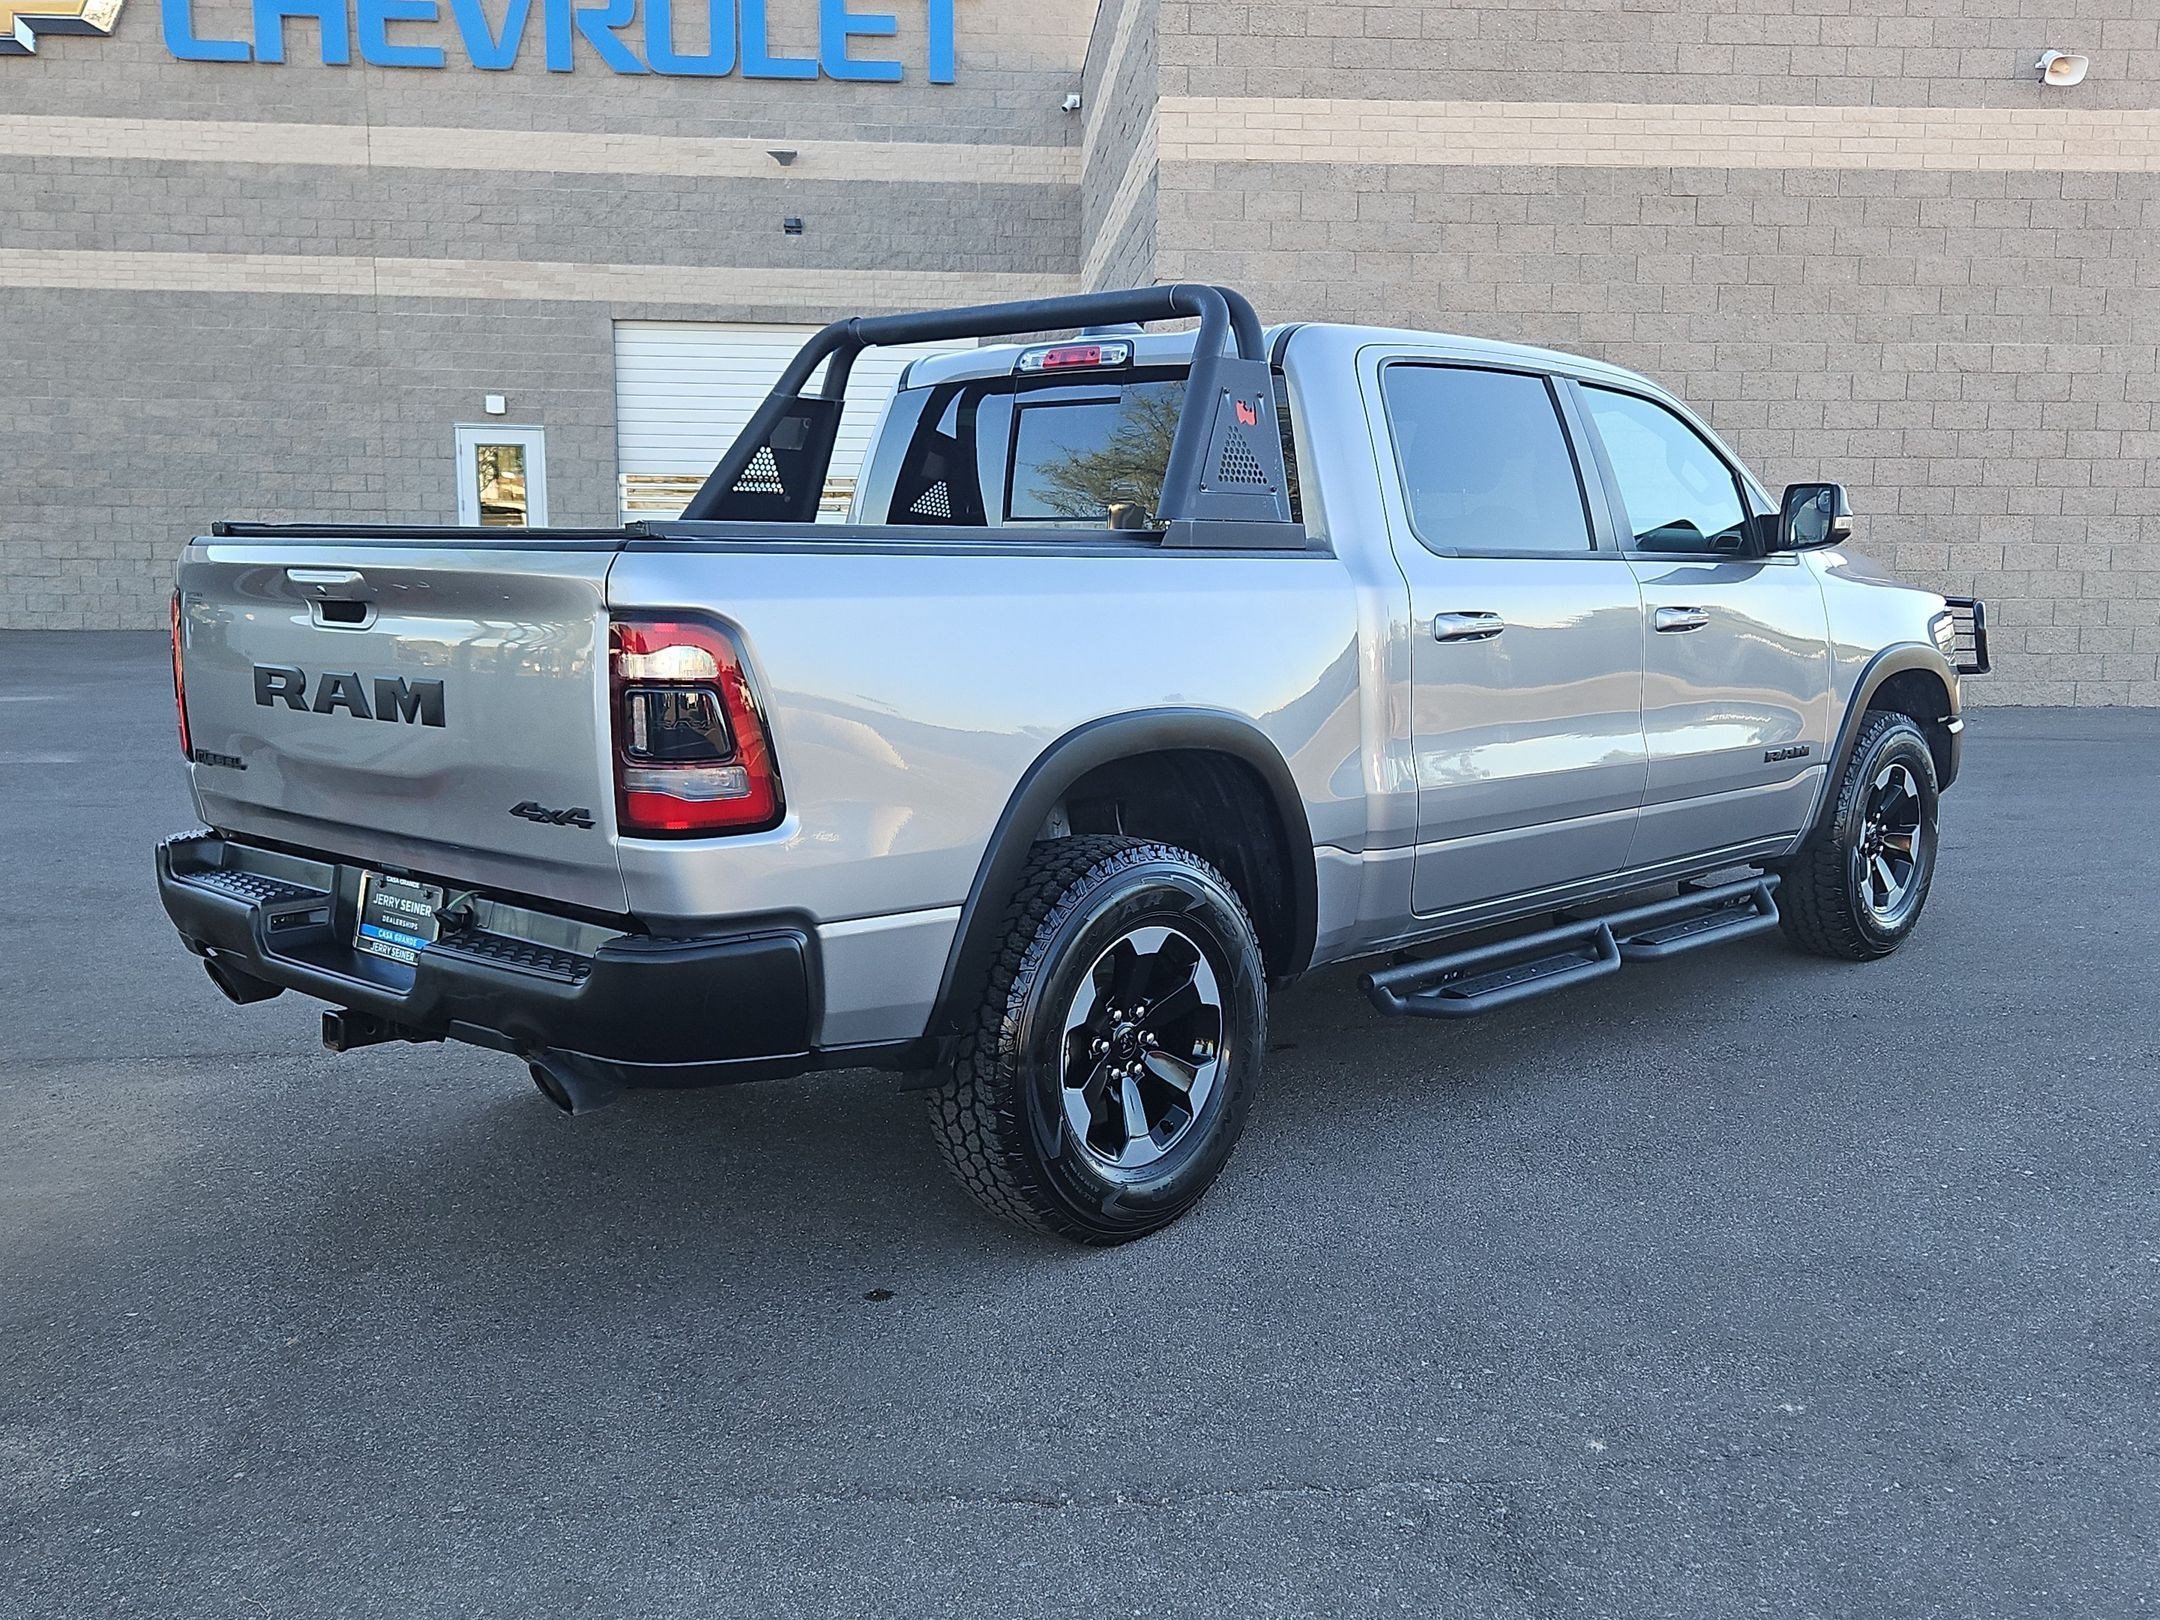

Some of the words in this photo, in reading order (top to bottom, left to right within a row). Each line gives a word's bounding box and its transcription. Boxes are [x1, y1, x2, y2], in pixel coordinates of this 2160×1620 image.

[252, 662, 447, 728] RAM
[373, 892, 400, 909] JERRY
[400, 899, 432, 917] SEINER
[382, 915, 418, 931] DEALERSHIPS
[378, 928, 394, 941] CASA
[394, 932, 418, 947] GRANDE
[370, 941, 392, 955] JERRY
[391, 946, 415, 962] SEINER
